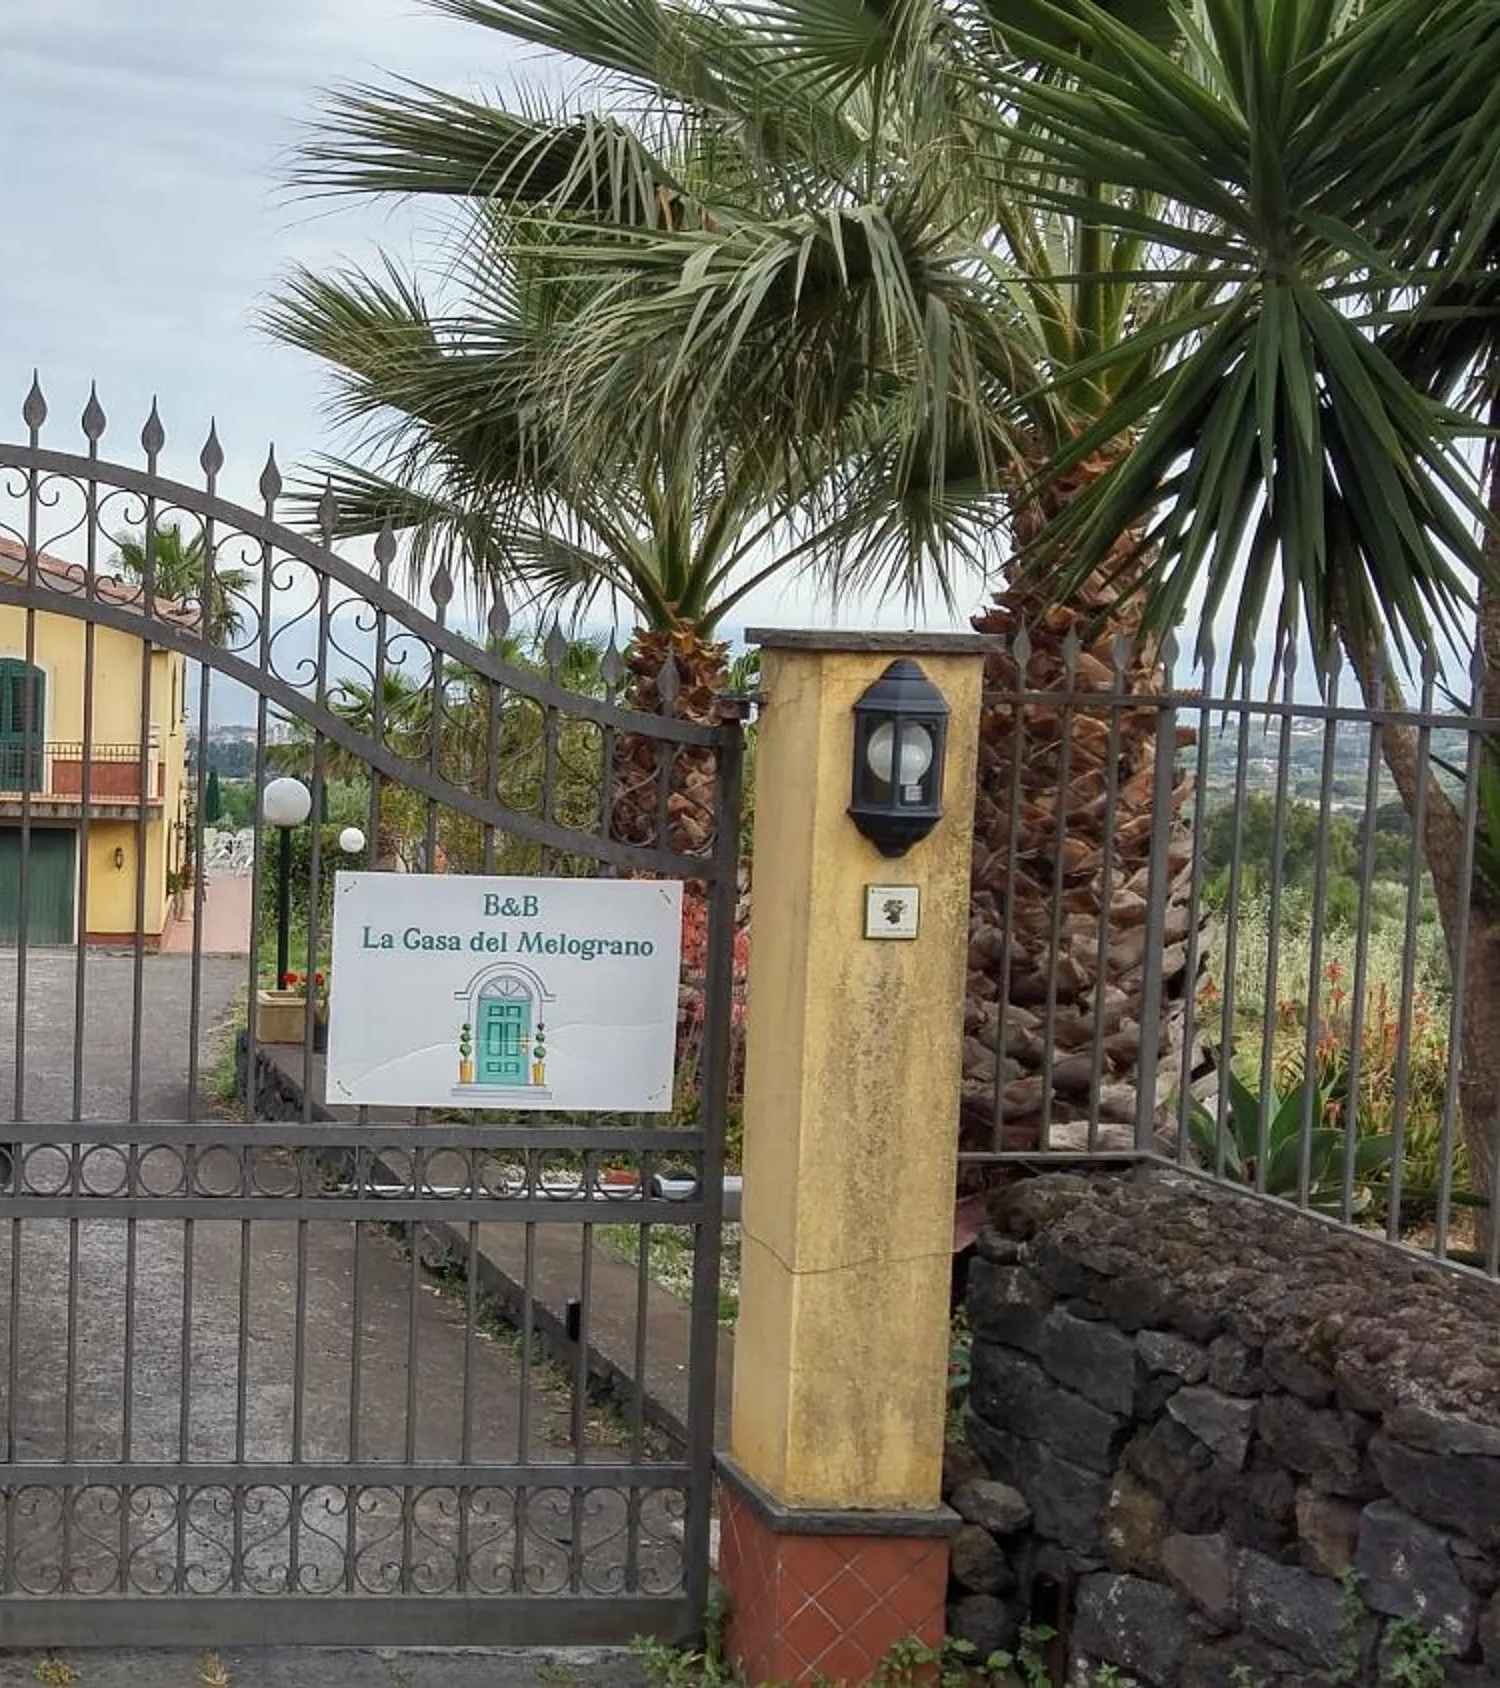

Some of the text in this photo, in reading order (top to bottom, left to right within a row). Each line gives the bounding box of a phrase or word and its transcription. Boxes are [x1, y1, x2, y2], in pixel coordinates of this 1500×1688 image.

[483, 893, 539, 917] B&B
[362, 926, 654, 961] La Casa del Melograno
